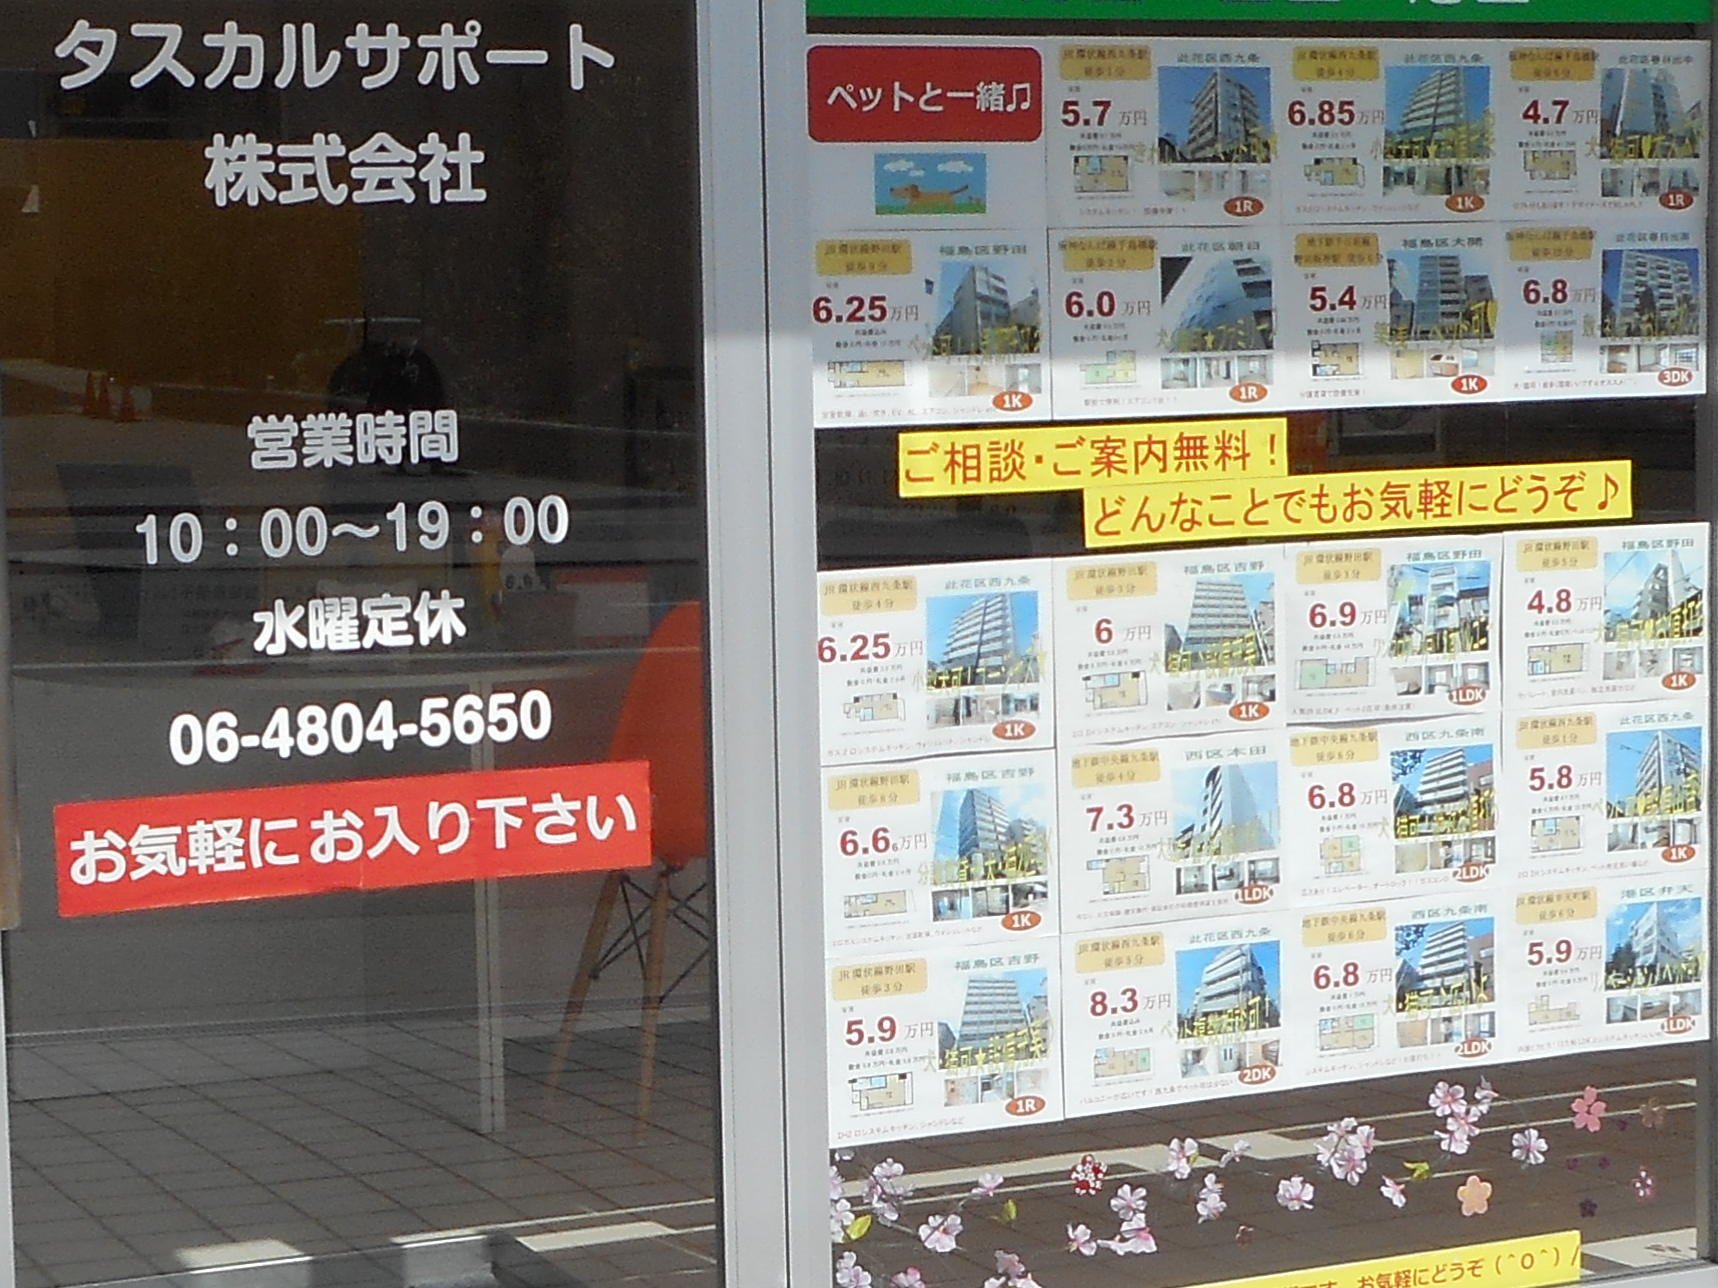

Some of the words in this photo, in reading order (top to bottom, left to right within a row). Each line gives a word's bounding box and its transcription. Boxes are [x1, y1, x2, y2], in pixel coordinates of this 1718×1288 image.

[53, 19, 616, 93] タスカルサポート
[203, 133, 487, 207] 株式会社
[1234, 200, 1254, 212] 1R
[1455, 197, 1474, 209] 1K
[1668, 195, 1685, 207] 1R
[1460, 378, 1479, 390] 1K
[1662, 370, 1690, 384] 3DK
[1239, 386, 1259, 399] 1R
[1002, 395, 1023, 408] 1K
[246, 410, 460, 471] 営業時間
[252, 591, 468, 657] 水曜定休
[1670, 675, 1688, 687] 1K
[1451, 689, 1484, 704] 1LDK
[1238, 704, 1260, 718] 1K
[168, 689, 553, 766] 06-4804-5650
[1004, 723, 1025, 737] 1K
[67, 790, 639, 887] お気軽にお入り下さい
[1669, 847, 1687, 859] 1K
[1011, 914, 1032, 927] 1K
[1242, 1068, 1273, 1083] 2DK
[1016, 1100, 1037, 1113] 1R
